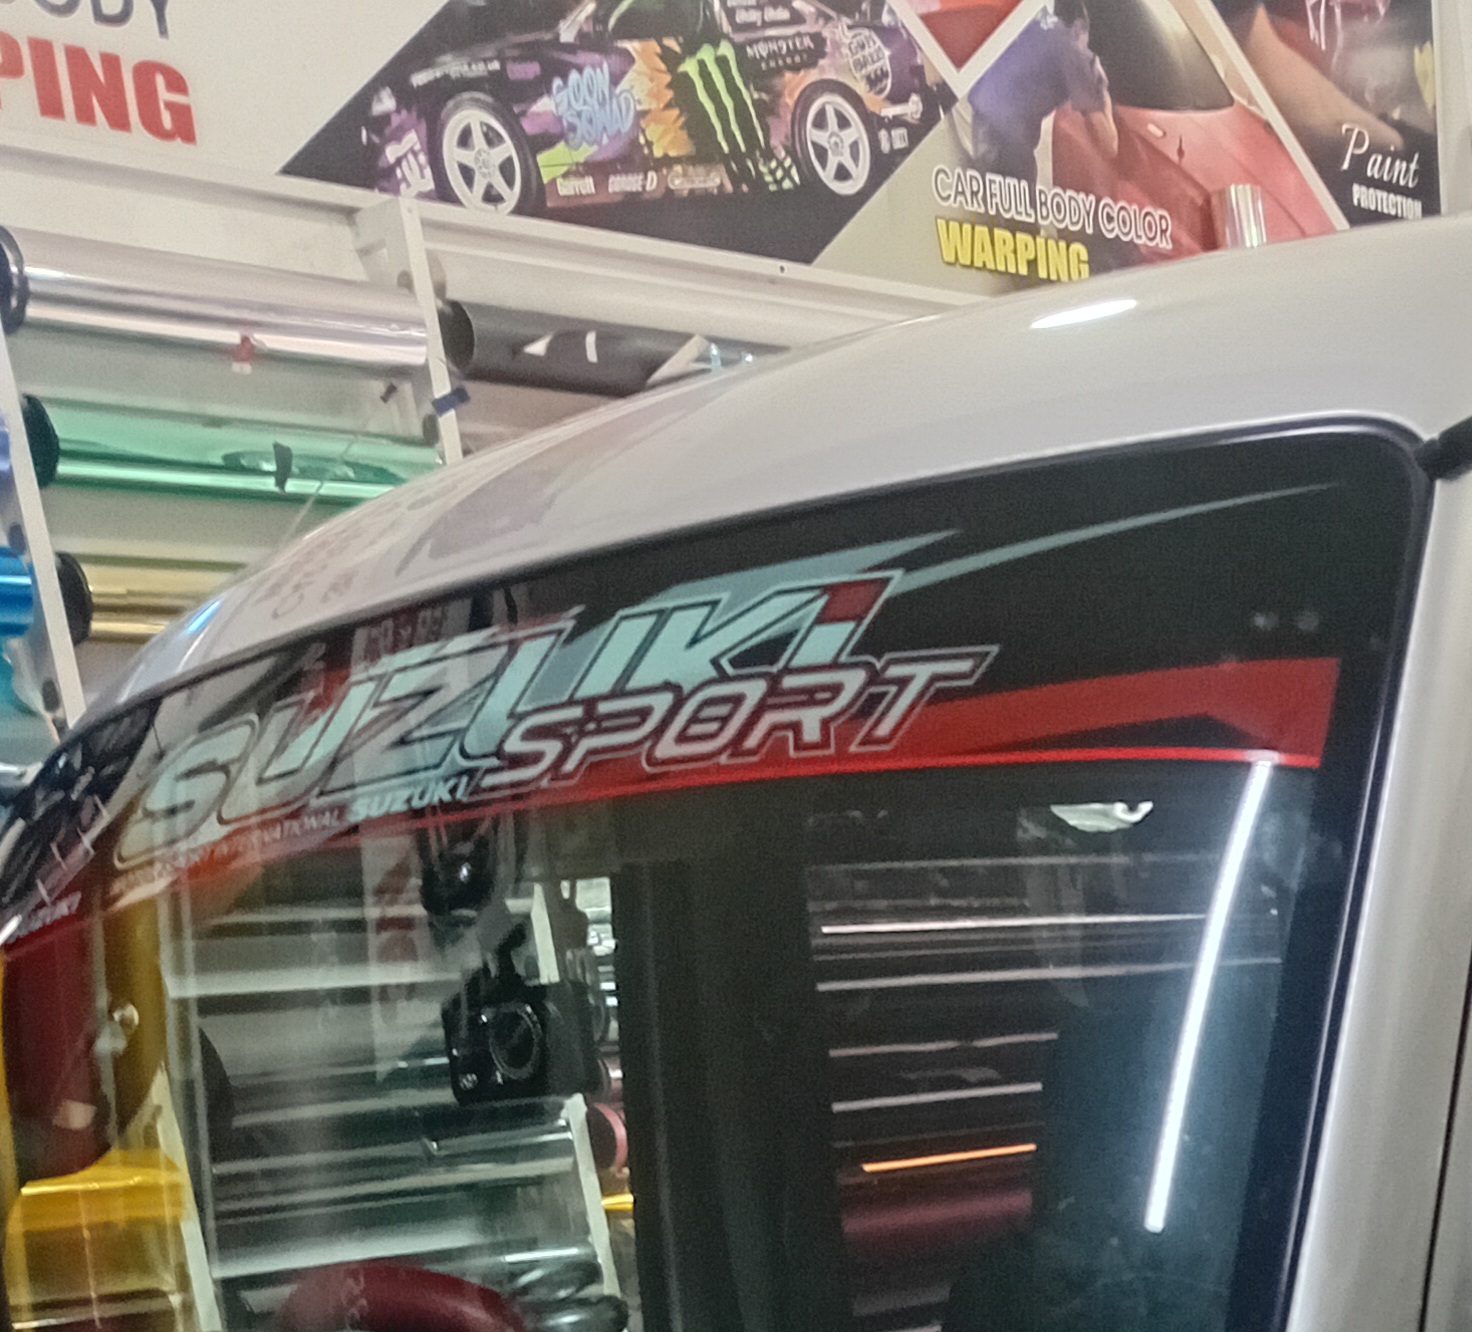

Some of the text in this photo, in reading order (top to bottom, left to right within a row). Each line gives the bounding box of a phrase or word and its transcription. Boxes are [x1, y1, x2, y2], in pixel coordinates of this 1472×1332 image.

[1341, 123, 1420, 188] Paint
[932, 164, 1173, 250] CAR FULL BODY COLOR
[1352, 182, 1423, 221] PROTECTION
[936, 218, 1090, 284] WARPING
[113, 568, 905, 871] SUZUKI
[480, 644, 1000, 801] SPORT
